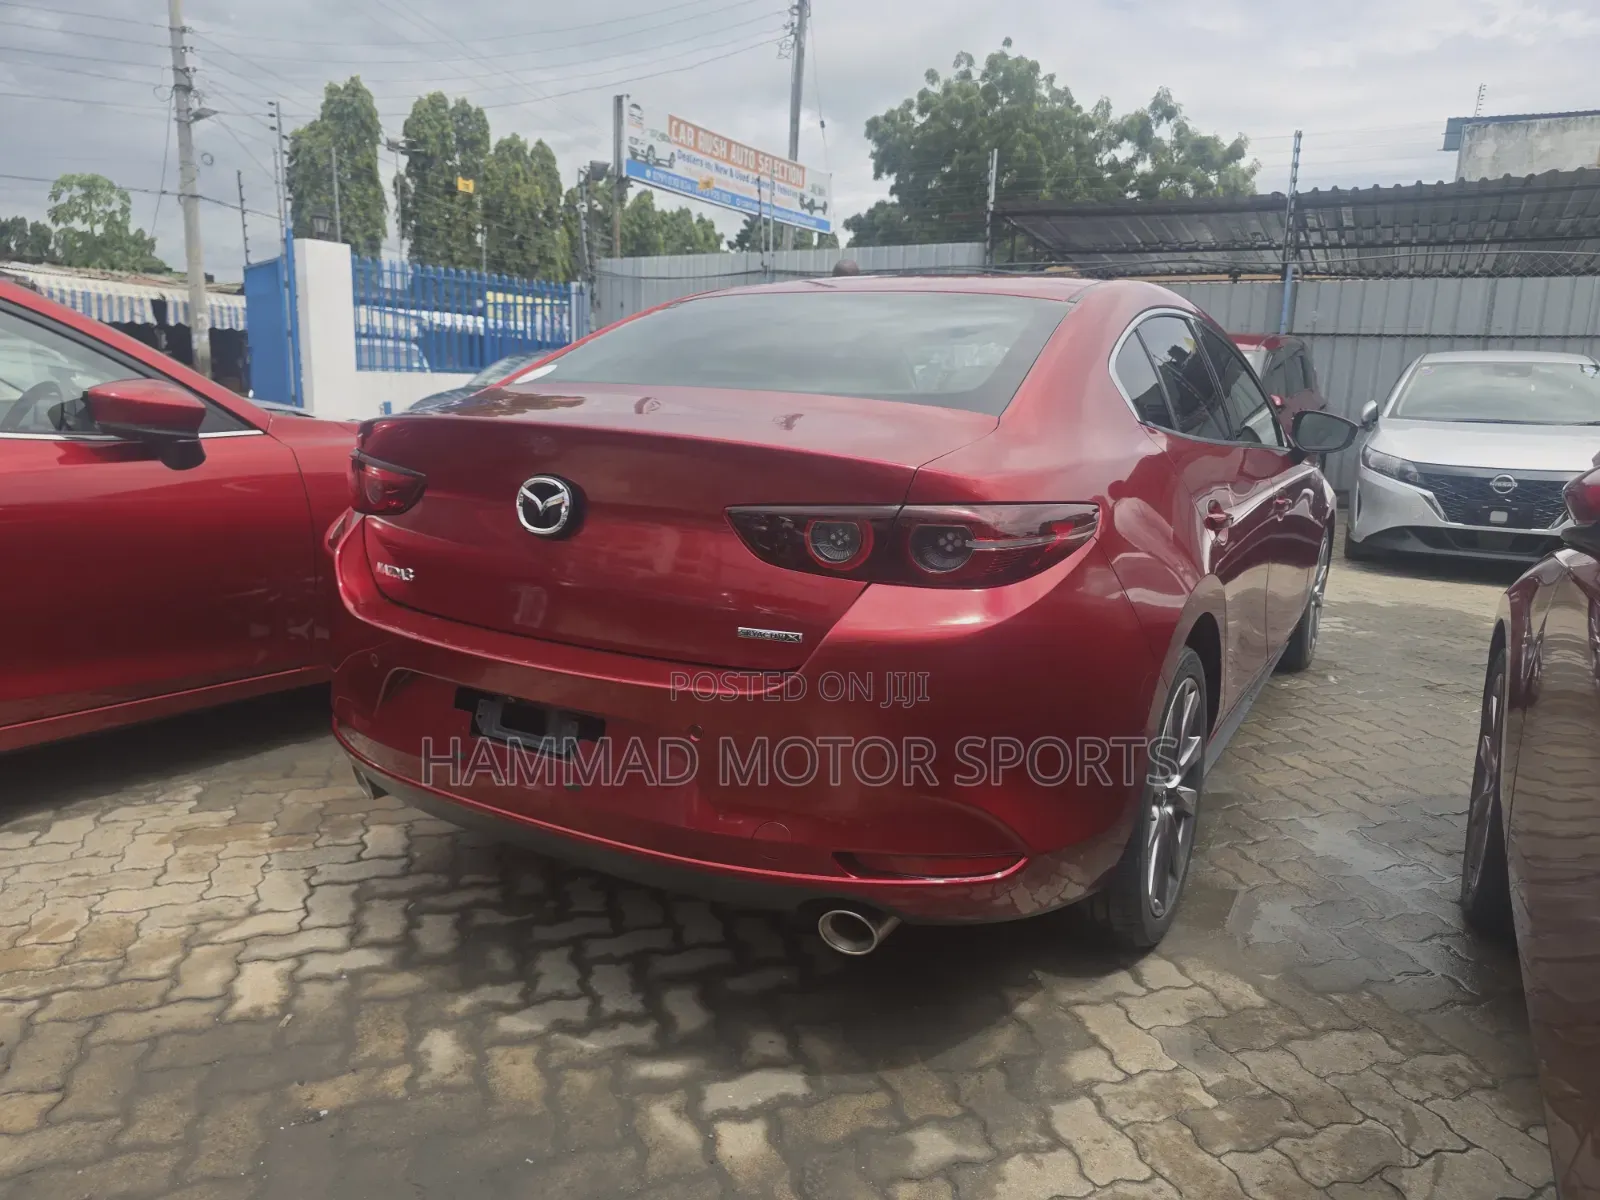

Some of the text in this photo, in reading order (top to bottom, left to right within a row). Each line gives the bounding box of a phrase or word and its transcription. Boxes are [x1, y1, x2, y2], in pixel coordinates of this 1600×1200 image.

[671, 120, 694, 147] CAR
[730, 143, 756, 169] AUTO
[758, 154, 804, 185] SELECTION
